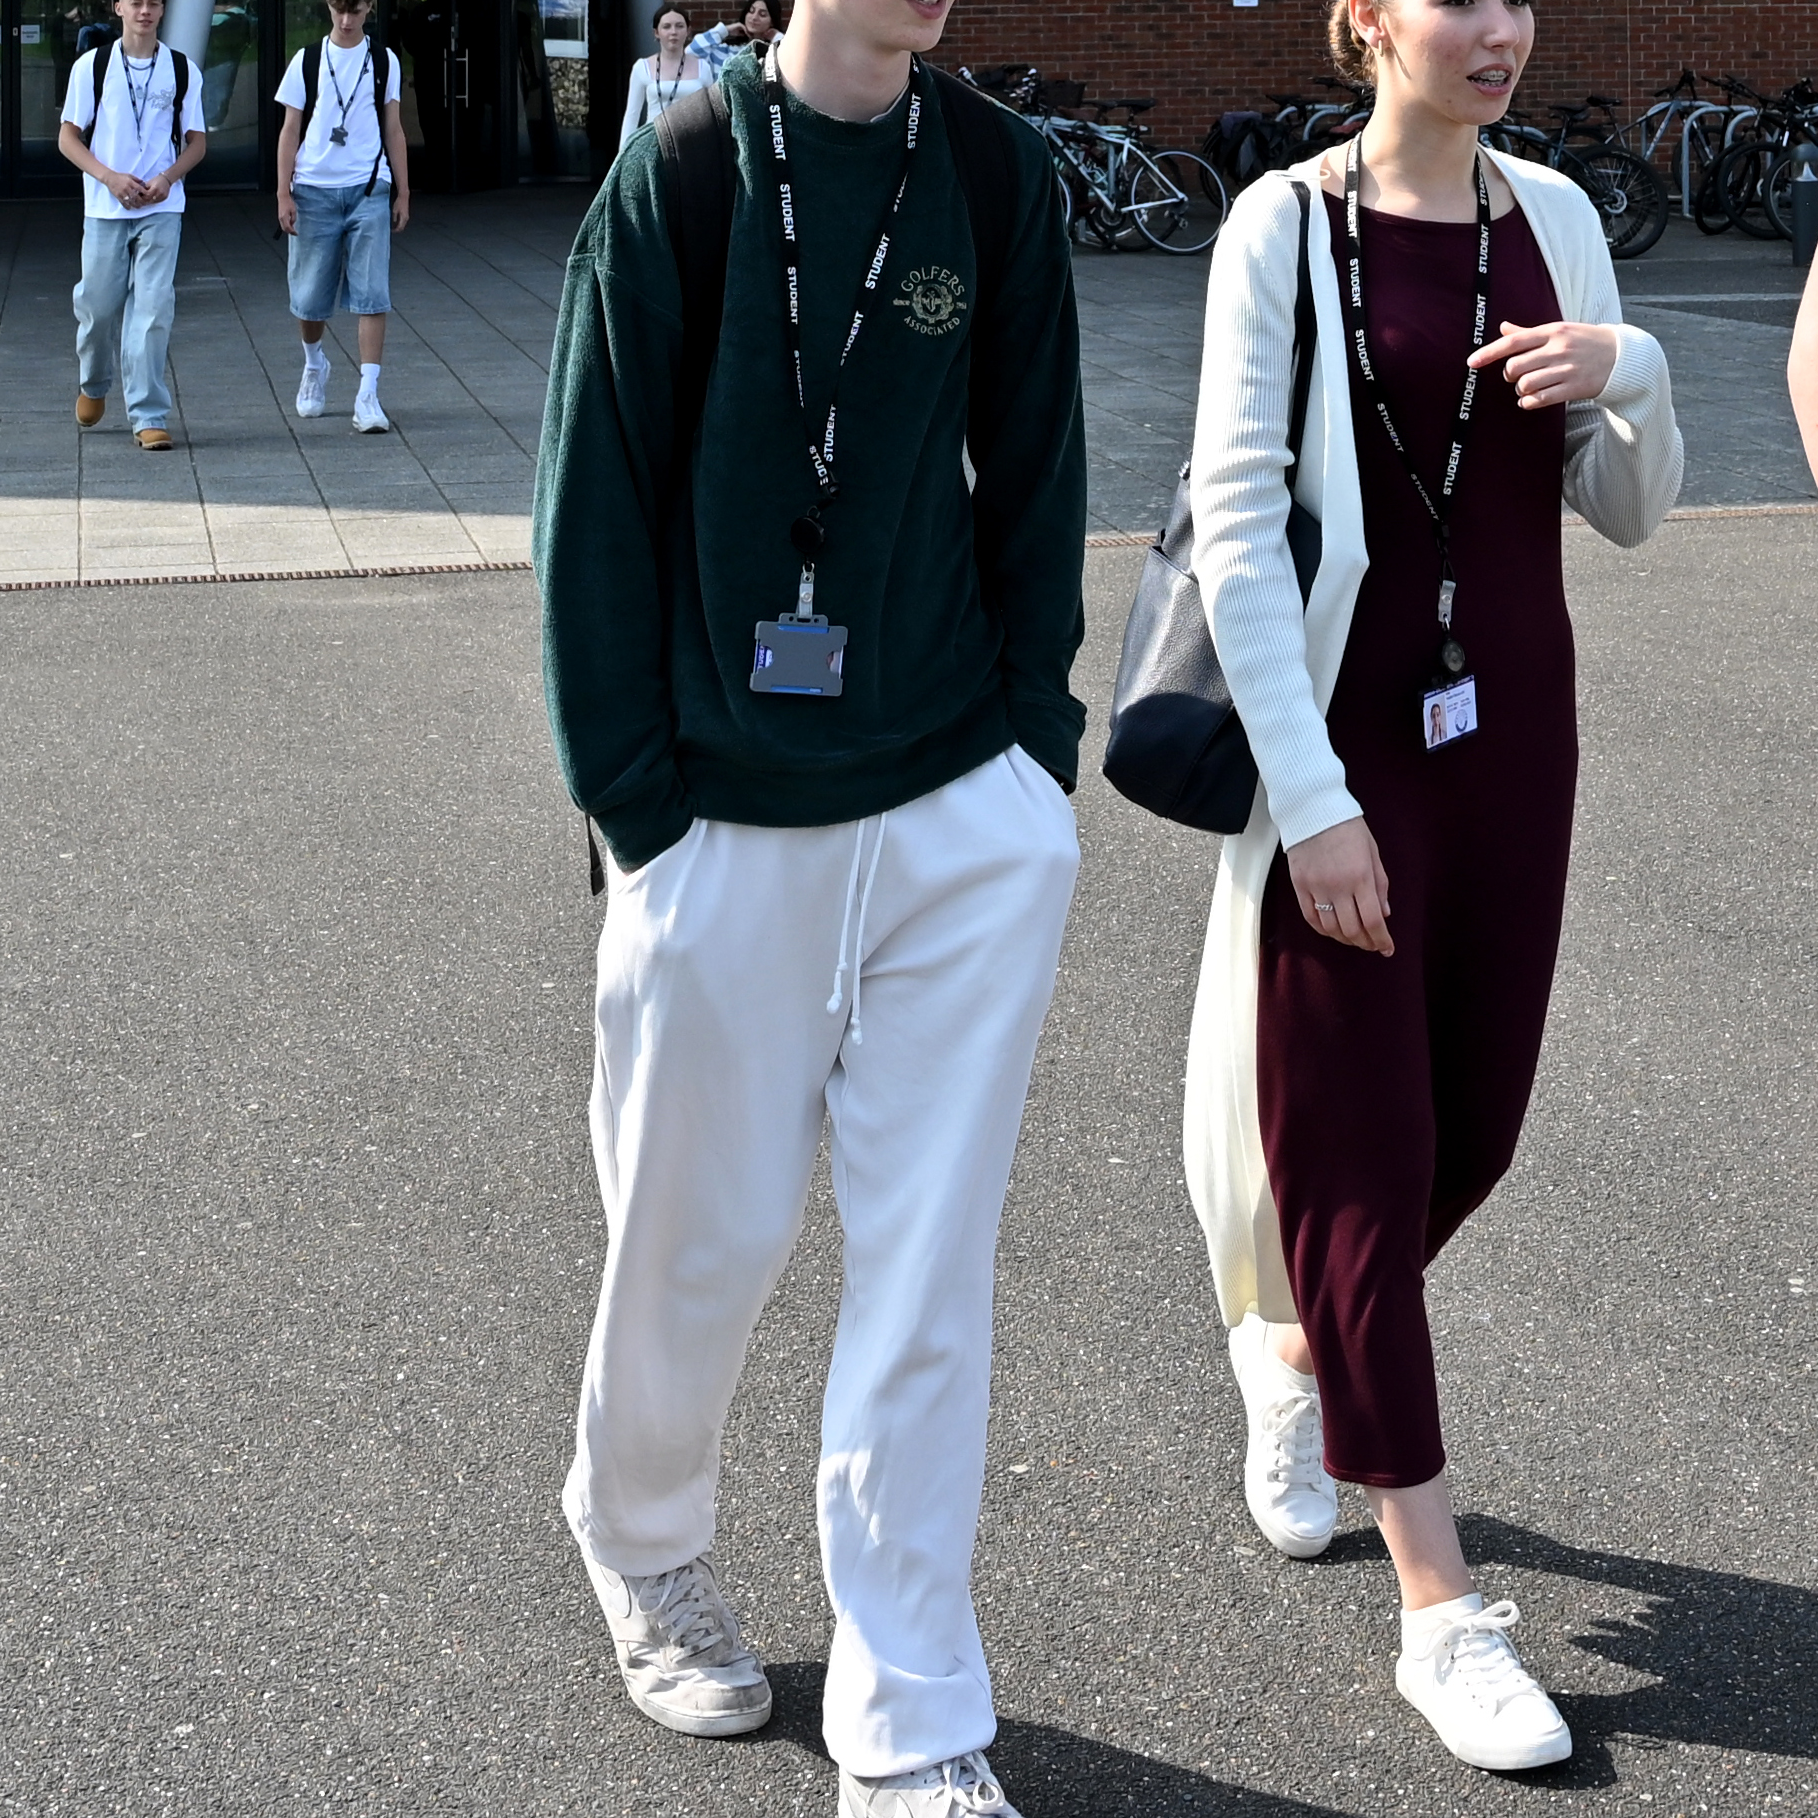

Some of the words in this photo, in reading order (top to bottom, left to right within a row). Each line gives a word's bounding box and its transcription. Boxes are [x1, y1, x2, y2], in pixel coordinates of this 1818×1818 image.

[769, 104, 786, 161] STUDENT
[907, 93, 921, 149] STUDENT
[779, 183, 796, 242] STUDENT
[1347, 190, 1358, 238] STUDENT
[865, 233, 891, 290] STUDENT
[1478, 223, 1489, 274] STUDENT
[787, 266, 798, 325] STUDENT
[900, 265, 965, 296] GOLFERS
[1349, 257, 1362, 308] STUDENT
[840, 310, 865, 367] STUDENT
[904, 315, 961, 336] ASSOCIATED
[1473, 293, 1487, 345] STUDENT
[1355, 329, 1375, 381] STUDENT
[1459, 367, 1479, 421] STUDENT
[823, 404, 837, 462] STUDENT
[1377, 402, 1404, 453] STUDENT
[809, 445, 829, 486] STUDE
[1442, 441, 1463, 496] STUDENT
[1410, 473, 1440, 520] STUDENT
